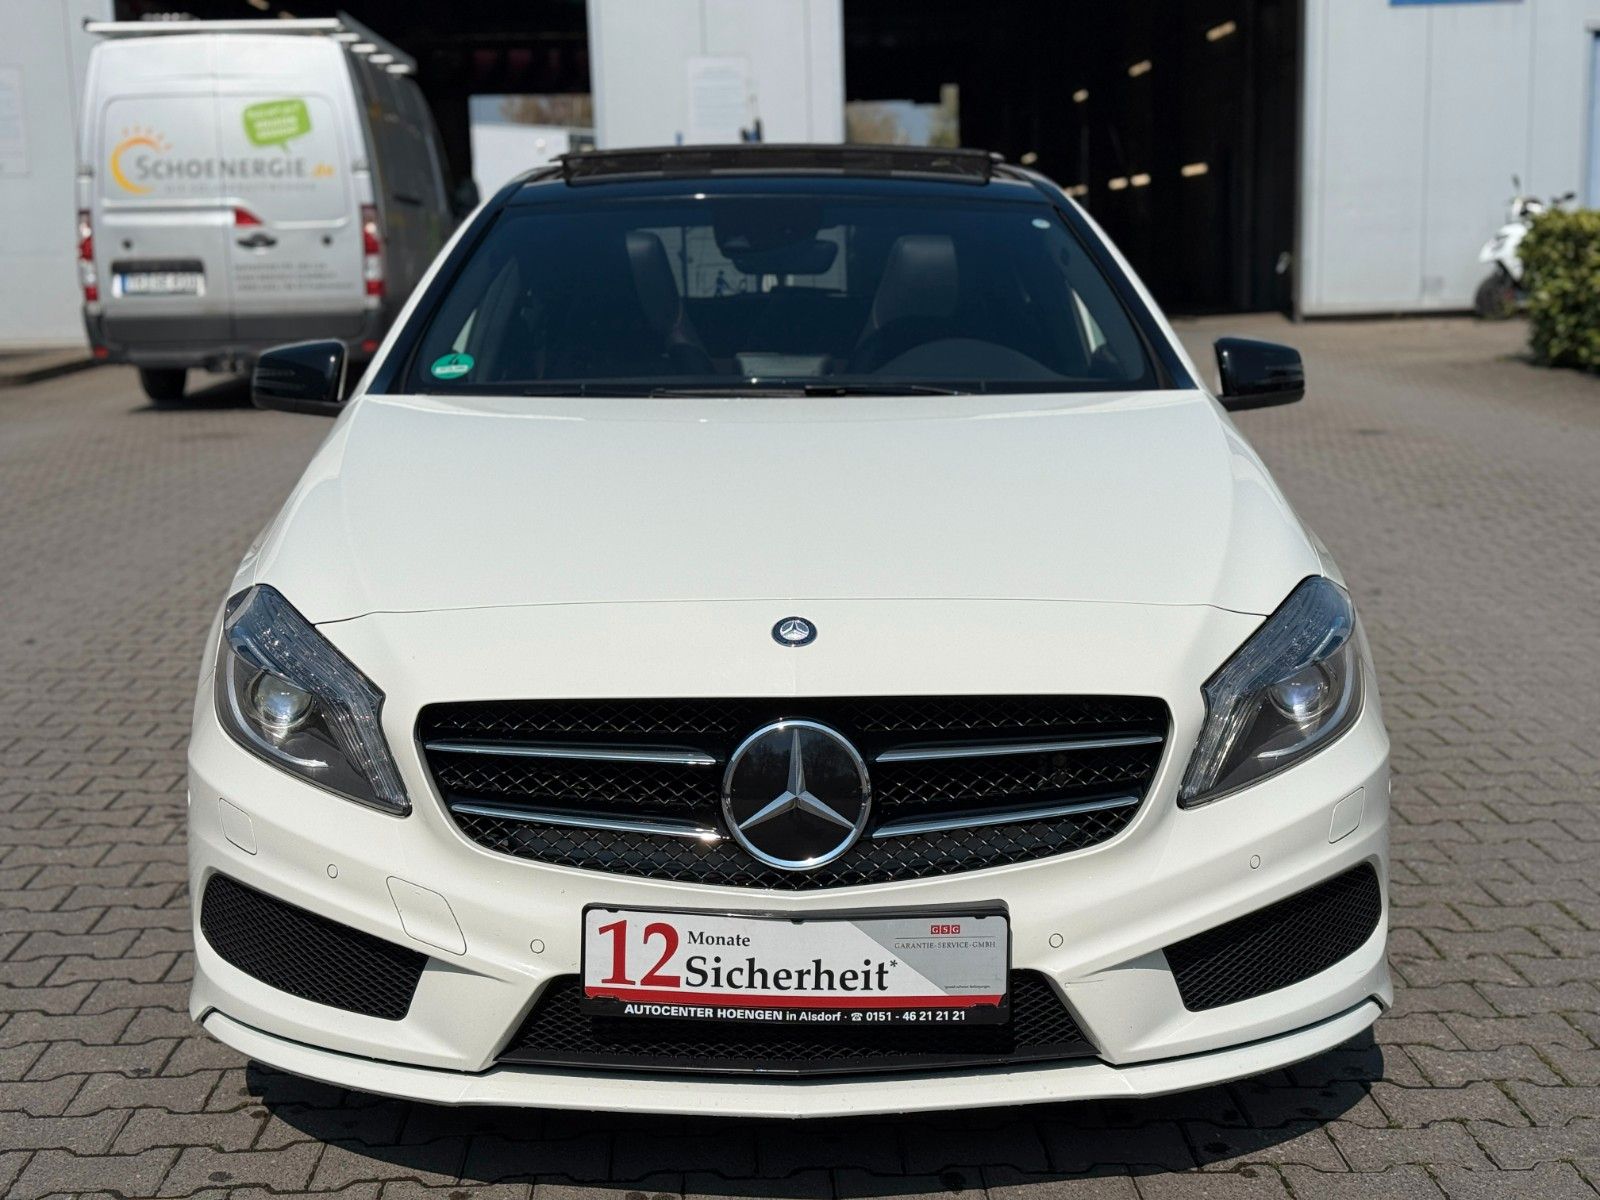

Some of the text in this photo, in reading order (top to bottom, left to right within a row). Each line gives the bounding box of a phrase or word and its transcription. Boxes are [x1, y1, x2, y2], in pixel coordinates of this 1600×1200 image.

[687, 930, 751, 947] Monate
[931, 925, 960, 934] GSG
[598, 919, 681, 988] 12
[624, 1003, 714, 1018] AUTOCENTER
[717, 1009, 783, 1021] HOENGEN
[786, 1011, 797, 1021] in
[799, 1011, 842, 1022] Alsdorf
[866, 1012, 892, 1021] 0151
[902, 1011, 917, 1021] 46
[919, 1011, 932, 1021] 21
[936, 1011, 949, 1021] 21
[952, 1011, 966, 1021] 21
